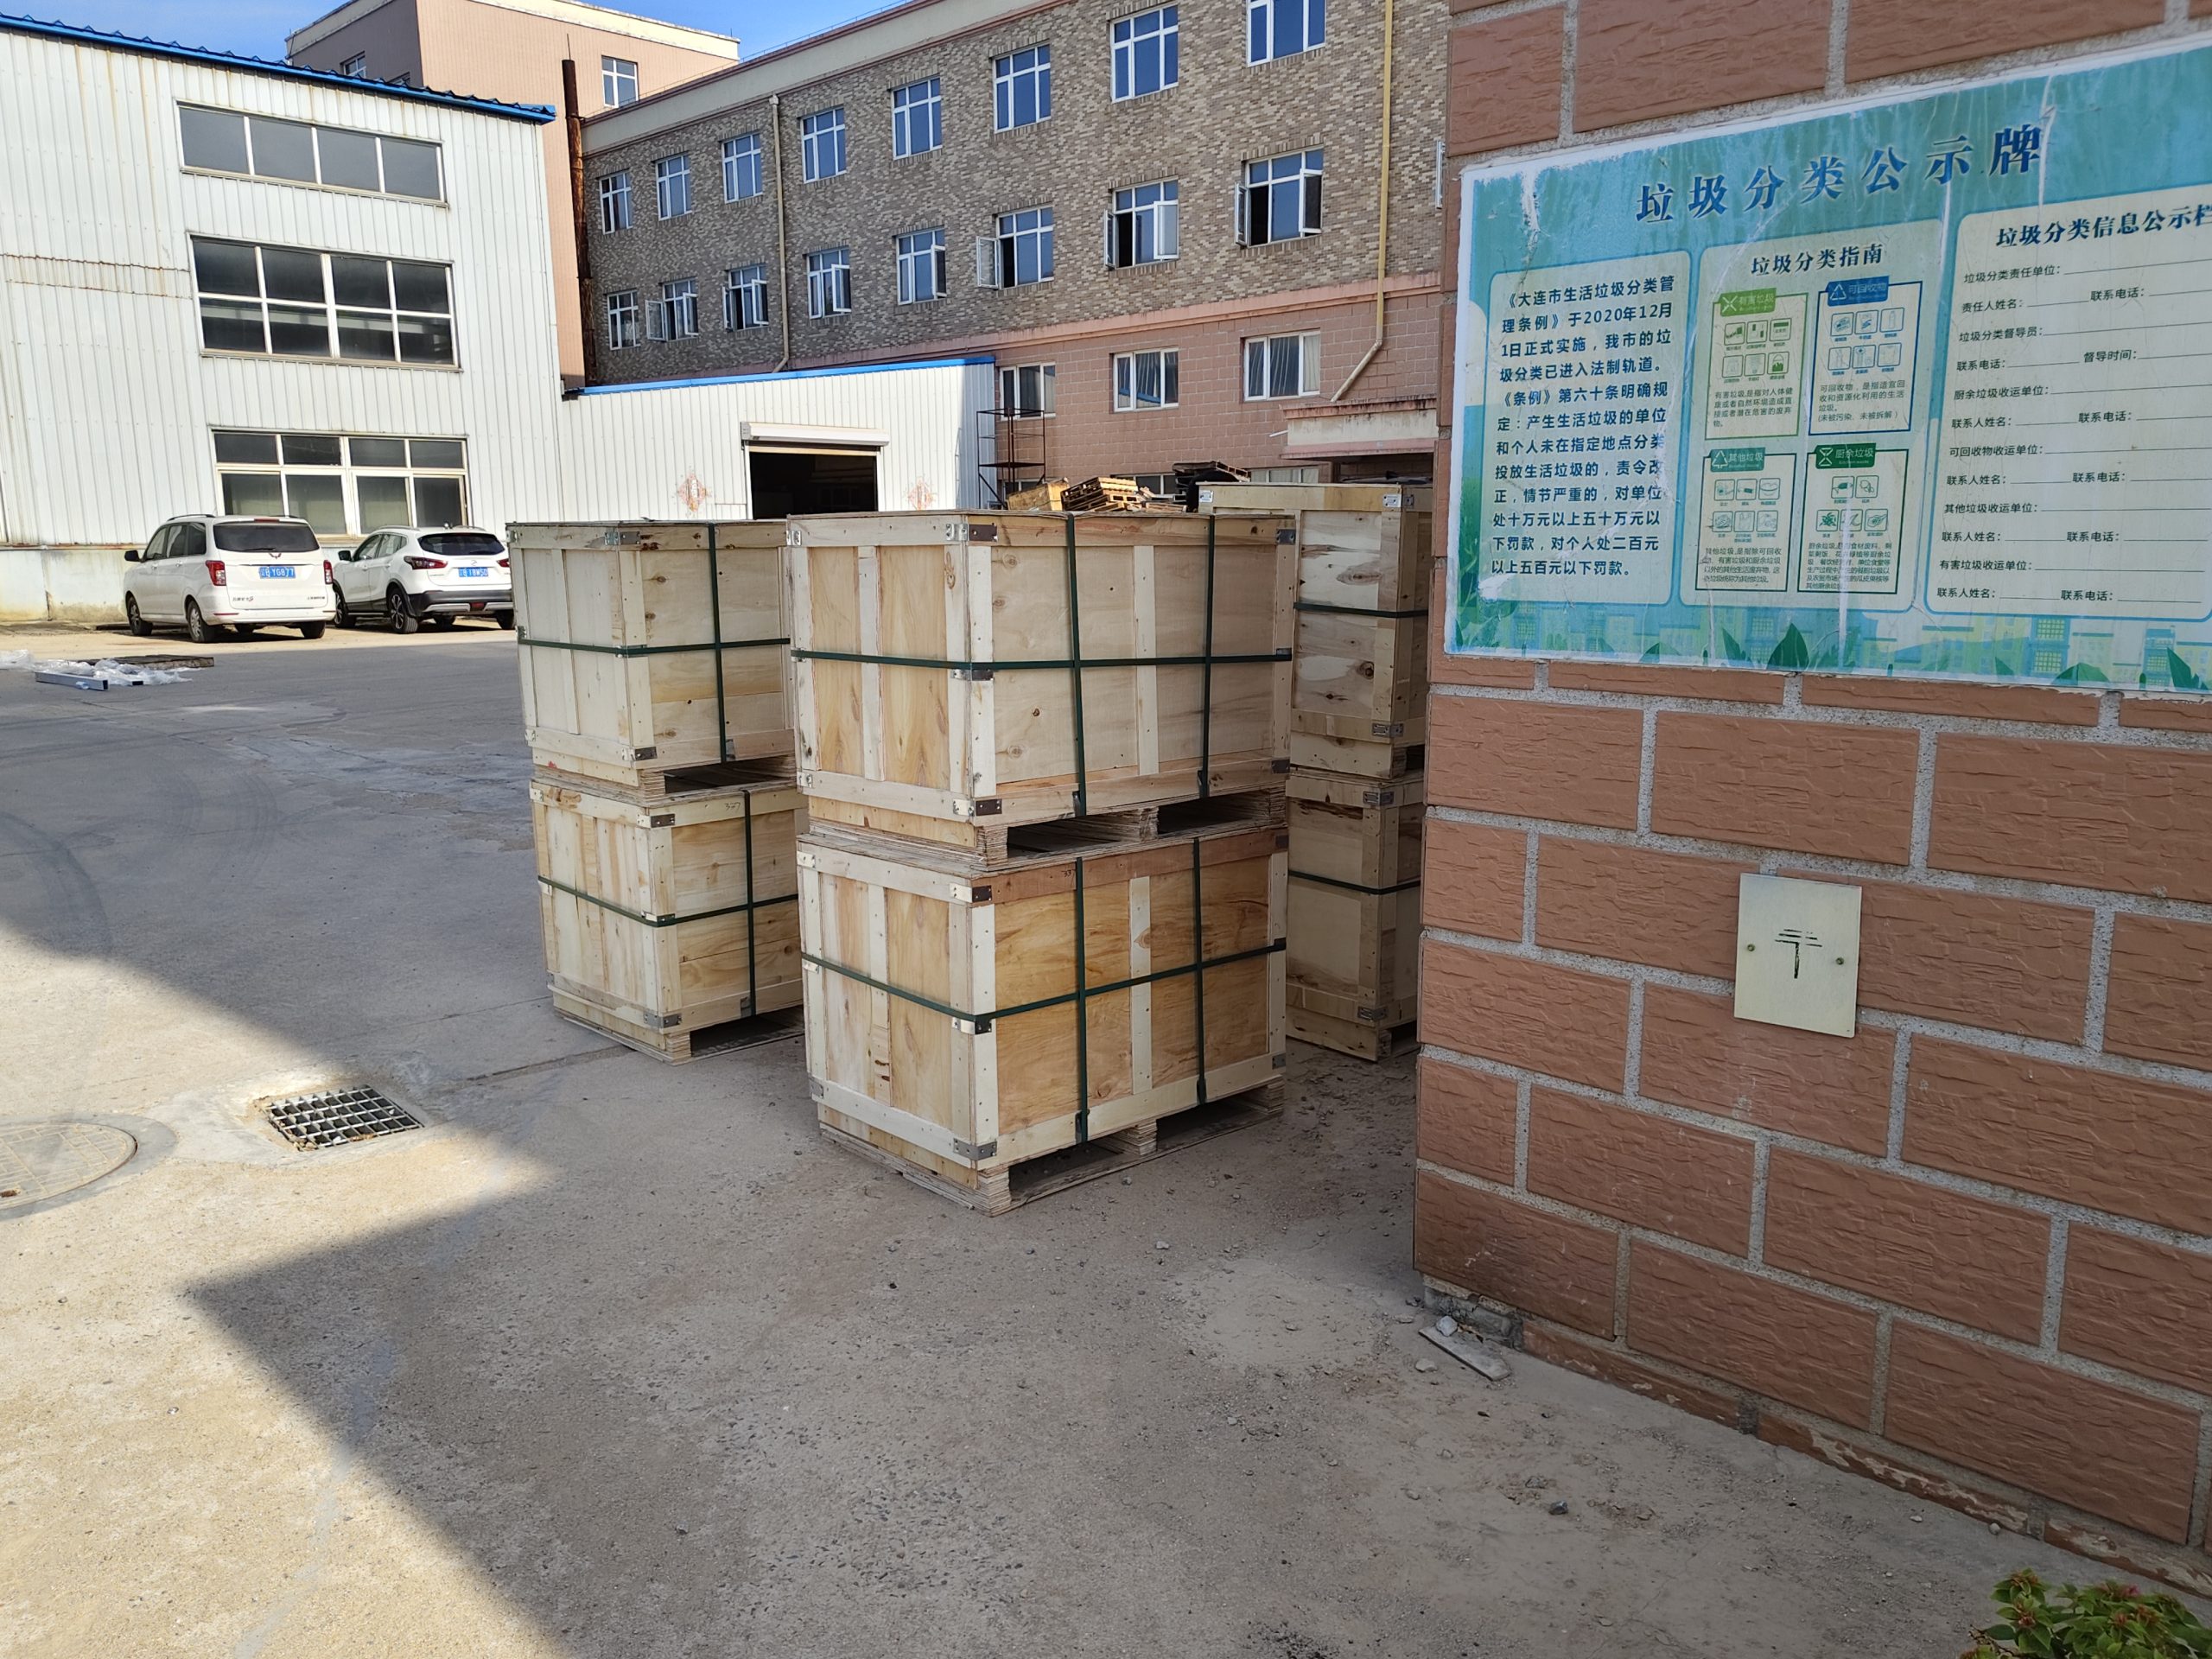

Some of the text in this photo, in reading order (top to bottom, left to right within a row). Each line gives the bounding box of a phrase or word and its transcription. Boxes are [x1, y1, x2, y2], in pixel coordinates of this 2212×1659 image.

[1636, 124, 2042, 222] 垃圾分类公示牌
[1996, 204, 2212, 248] 垃圾分类信息公示栏
[1751, 243, 1883, 276] 垃圾分类指南
[1963, 264, 2061, 283] 垃圾分类责任单位：
[1509, 275, 1675, 308] 《大连市生活垃圾分类管
[1961, 287, 2145, 315] 责任人姓名： 联系电话：
[1502, 302, 1673, 334] 理条例》于2020年12月
[1501, 328, 1671, 358] 1日正式实施，我市的垃
[1959, 326, 2043, 342] 垃圾分类督导员：
[1500, 356, 1661, 383] 圾分类已进入法制轨道。
[1956, 349, 2138, 372] 联系电话： 督导时间：
[1503, 381, 1668, 407] 《条例》第六十条明确规
[1954, 385, 2050, 401] 厨余垃圾收运单位：
[1497, 408, 1667, 431] 定：产生生活垃圾的单位
[1951, 410, 2133, 429] 联系人姓名： 联系电话：
[1497, 433, 1664, 455] 和个人未在指定地点分类
[1835, 448, 1873, 459] 厨余垃圾
[1949, 445, 2044, 458] 可回收物收运单位：
[1728, 453, 1764, 462] 其他垃圾
[1947, 472, 2126, 486] 联系人姓名： 联系电话：
[1494, 485, 1662, 504] 正，情节严重的，对单位
[1944, 503, 2037, 514] 其他垃圾收运单位：
[1492, 511, 1660, 528] 处十万元以上五十万元以
[1492, 536, 1660, 551] 下罚款，对个人处二百元
[1942, 531, 2120, 543] 联系人姓名： 联系电话：
[1491, 560, 1630, 575] 以上五百元以下罚款。
[1939, 560, 2032, 571] 有害垃圾收运单位：
[1936, 588, 2113, 601] 联系人姓名： 联系电话：
